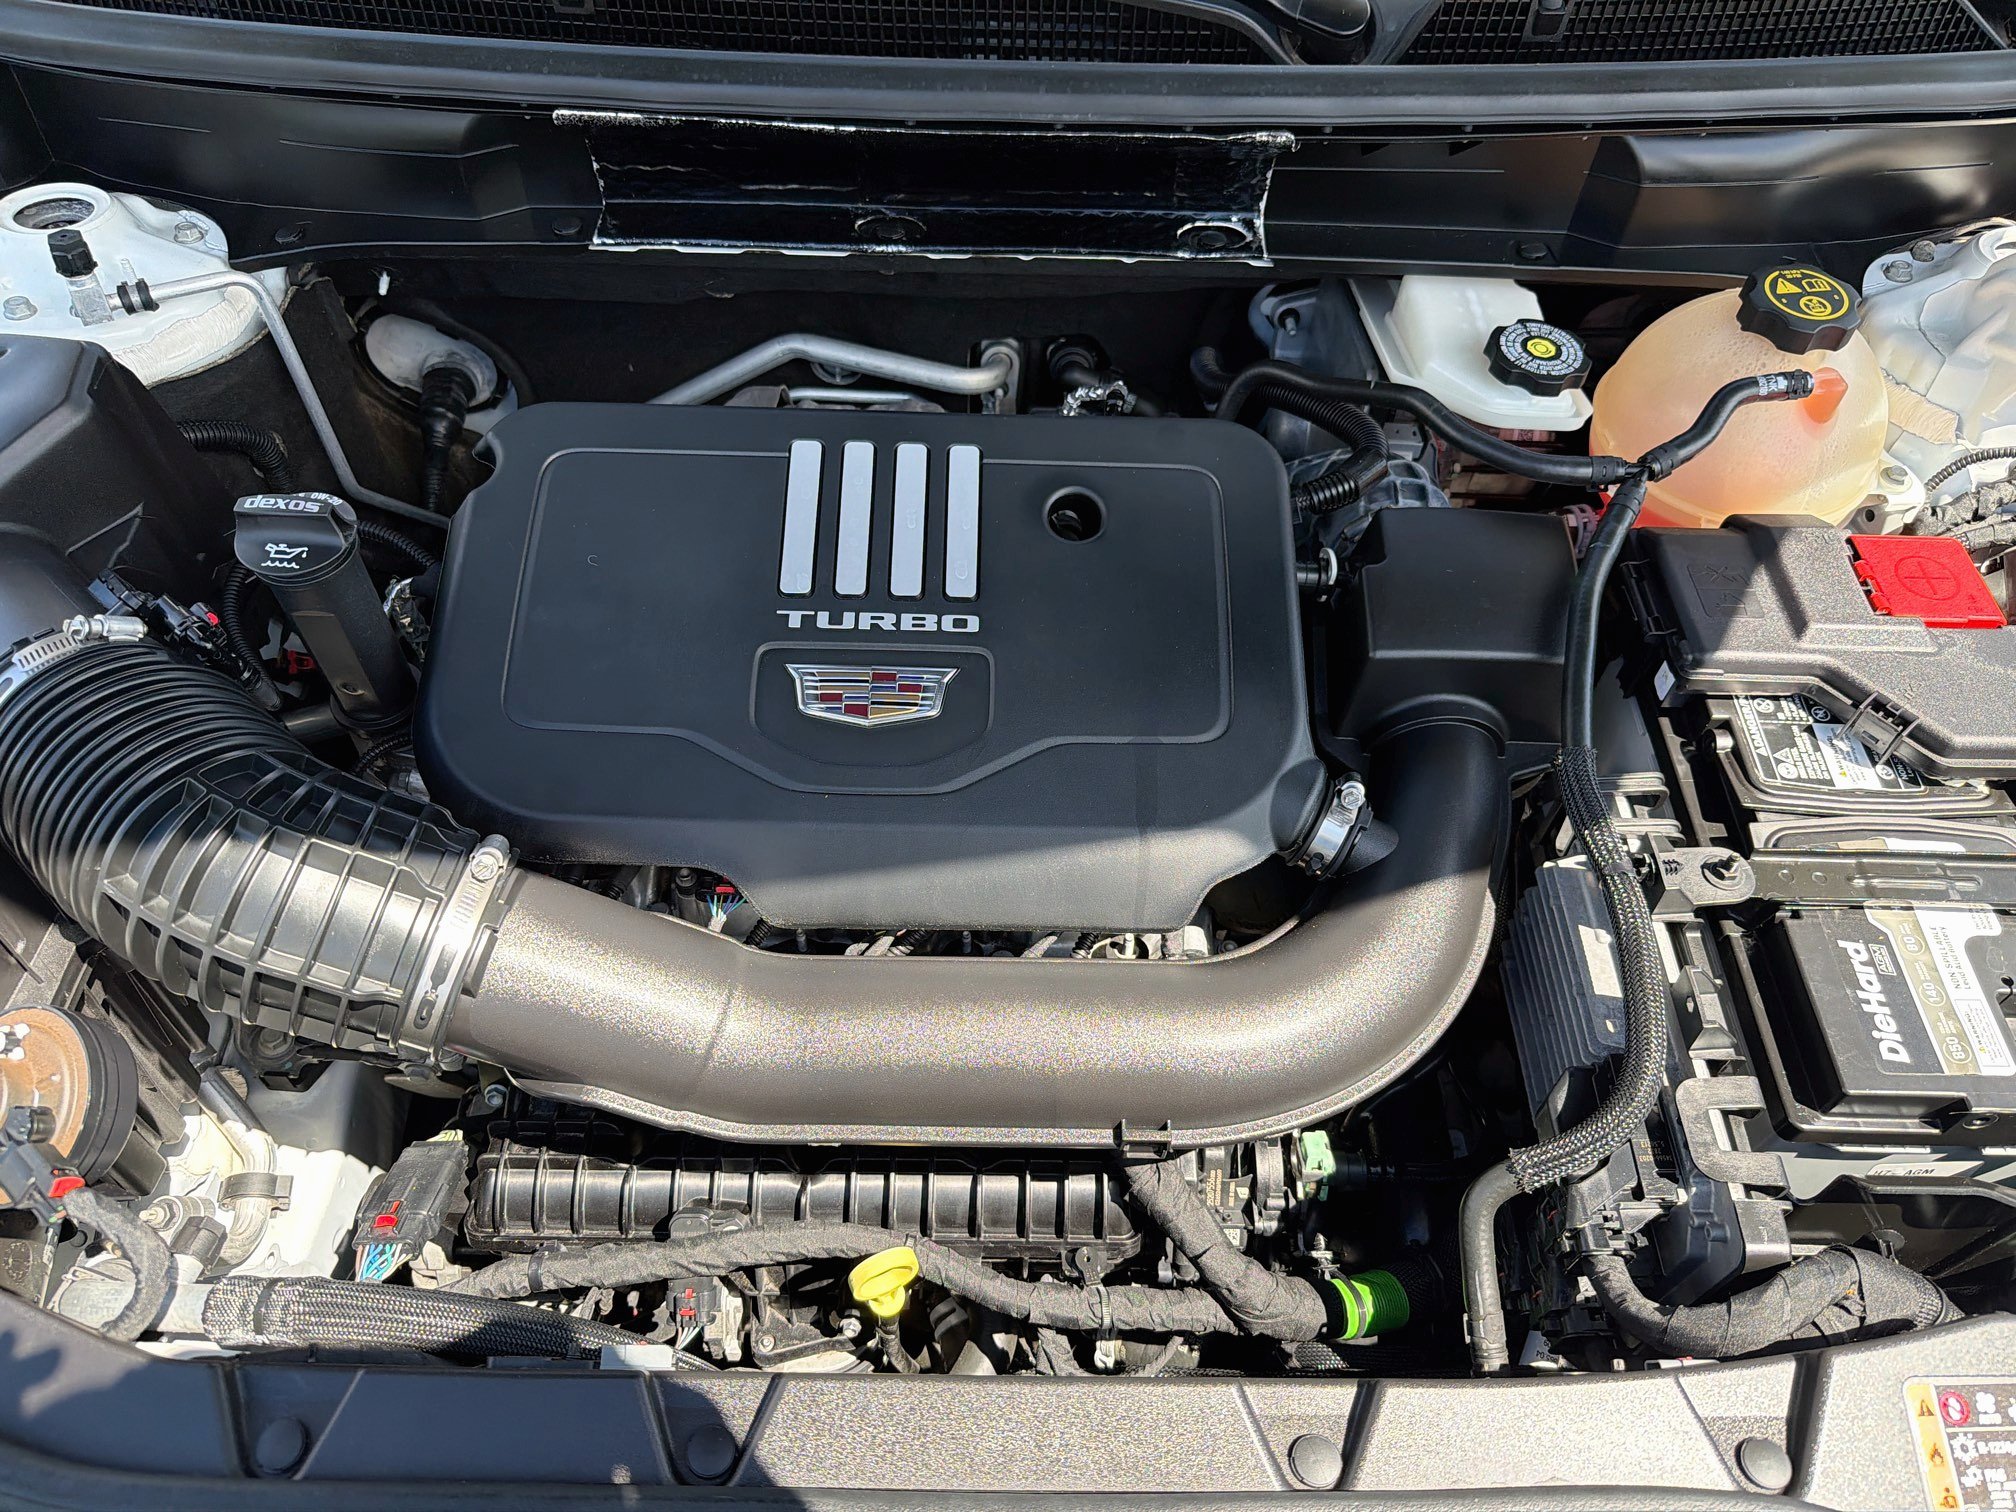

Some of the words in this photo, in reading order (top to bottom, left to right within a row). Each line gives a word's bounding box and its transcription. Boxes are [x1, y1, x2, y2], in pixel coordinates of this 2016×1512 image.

[244, 494, 320, 513] dexos
[310, 491, 343, 506] 0W-20
[776, 609, 980, 633] TURBO
[1903, 936, 1918, 951] 80
[1871, 946, 1888, 973] AGM
[1837, 939, 1911, 1064] DieHard
[1922, 982, 1940, 1003] 140
[1945, 1036, 1966, 1060] 850
[1903, 1168, 1936, 1176] AGM
